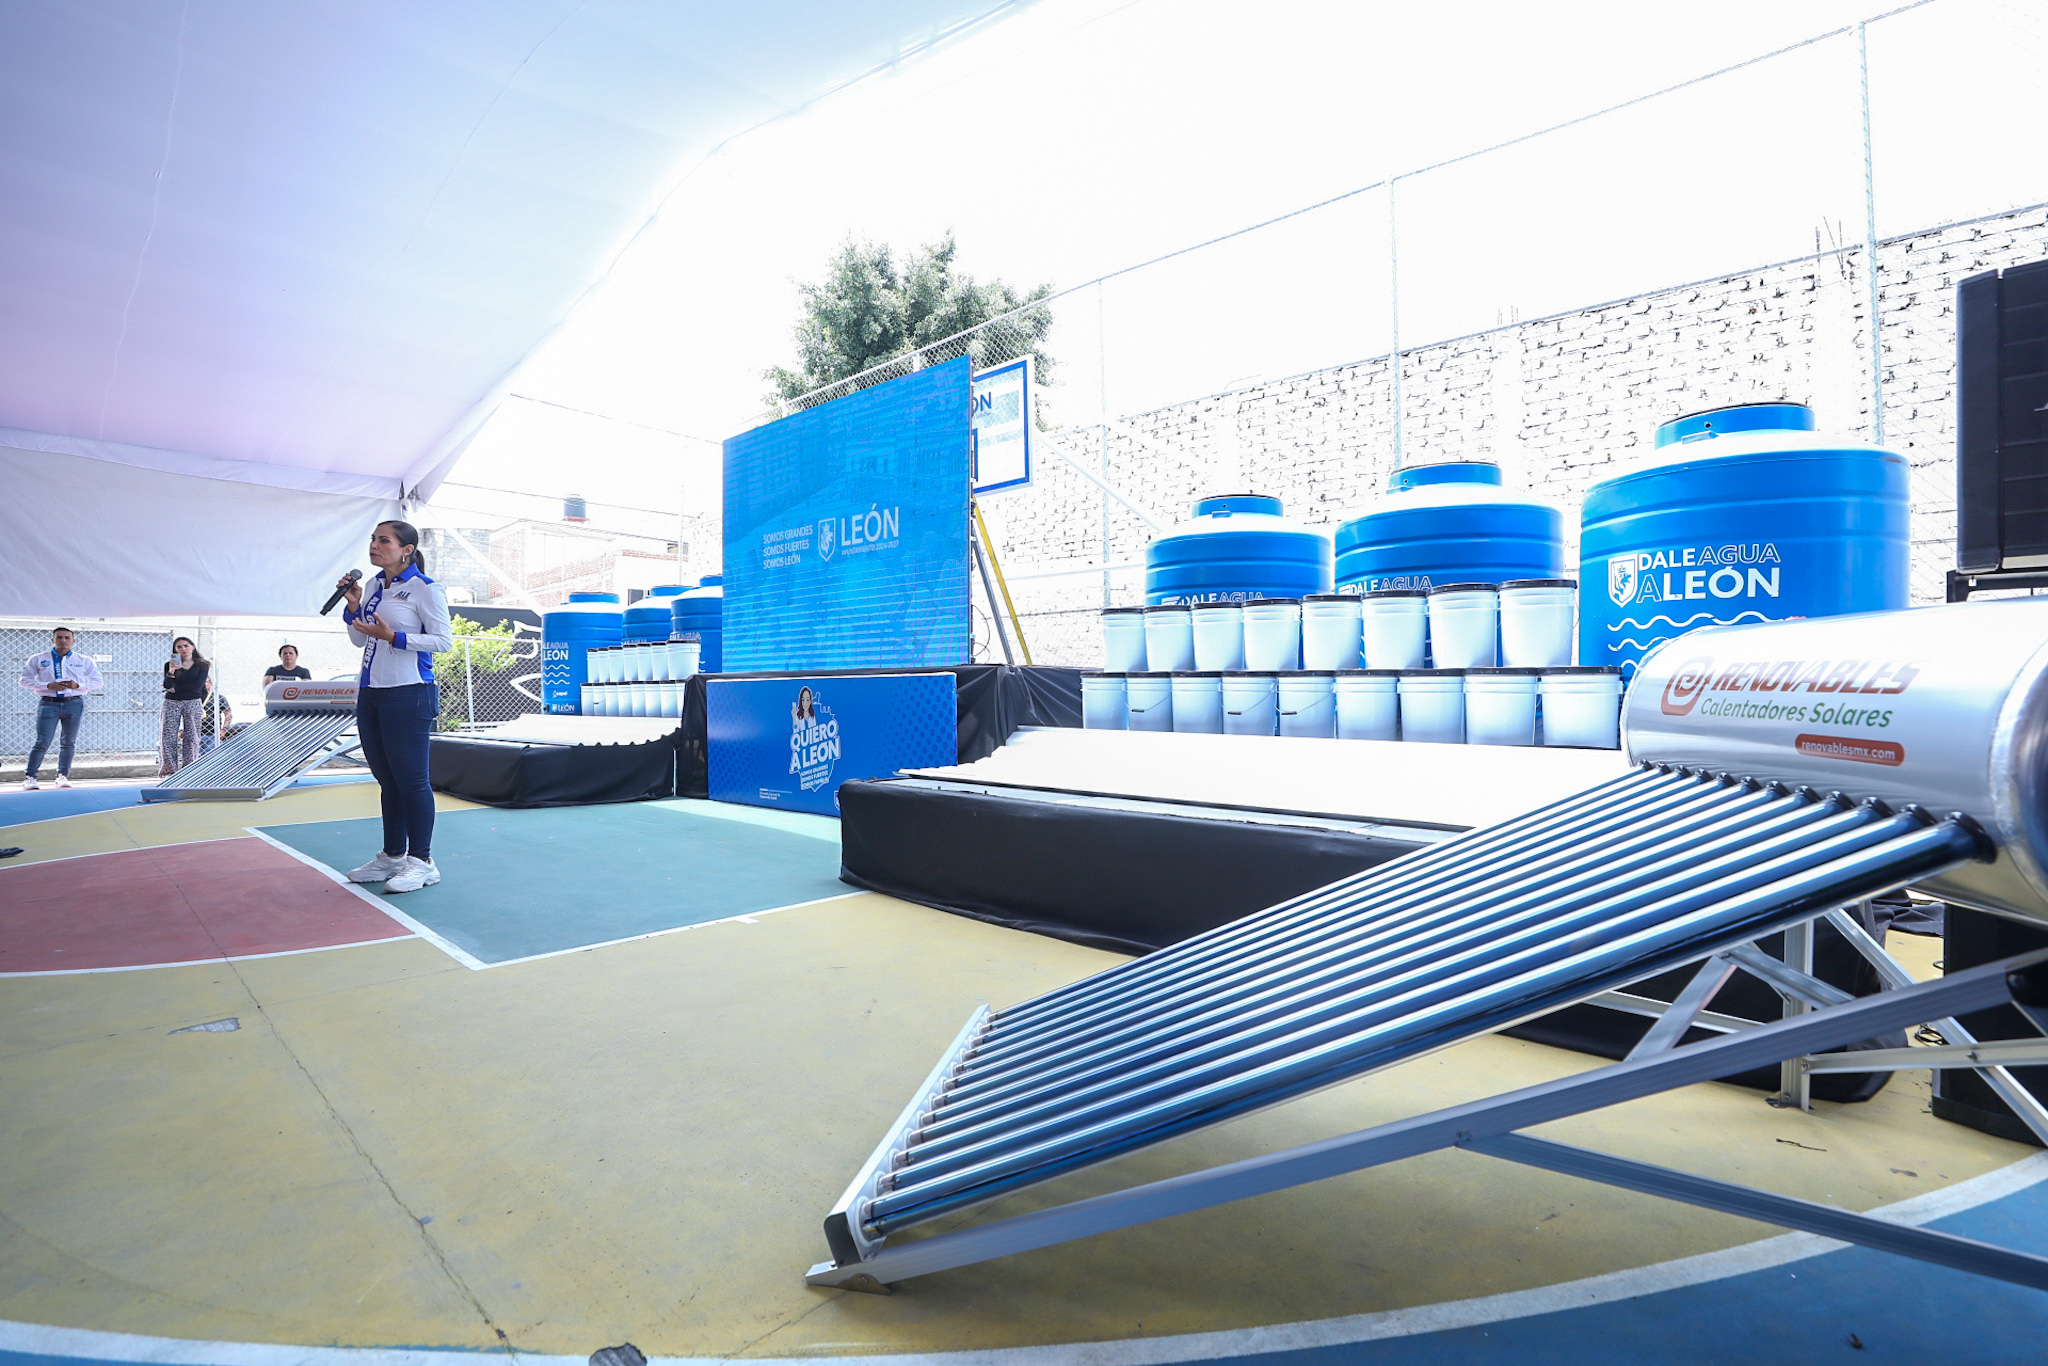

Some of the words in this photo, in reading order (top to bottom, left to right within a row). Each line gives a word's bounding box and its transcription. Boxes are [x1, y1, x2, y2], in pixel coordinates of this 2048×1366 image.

[763, 532, 784, 544] SOMOS
[784, 524, 813, 540] GRANDES
[841, 502, 899, 547] LEÓN
[763, 544, 784, 557] SOMOS
[784, 539, 810, 553] FUERTES
[763, 557, 784, 570] SOMOS
[784, 554, 801, 567] LEÓN
[1711, 657, 1921, 695] RENOVABLES
[1700, 697, 1807, 722] Calentadores
[1809, 702, 1894, 729] Solares
[791, 720, 836, 752] QUIERO
[1801, 740, 1895, 761] renovablesmx.com
[790, 751, 801, 772] A
[802, 737, 840, 768] LEÓN
